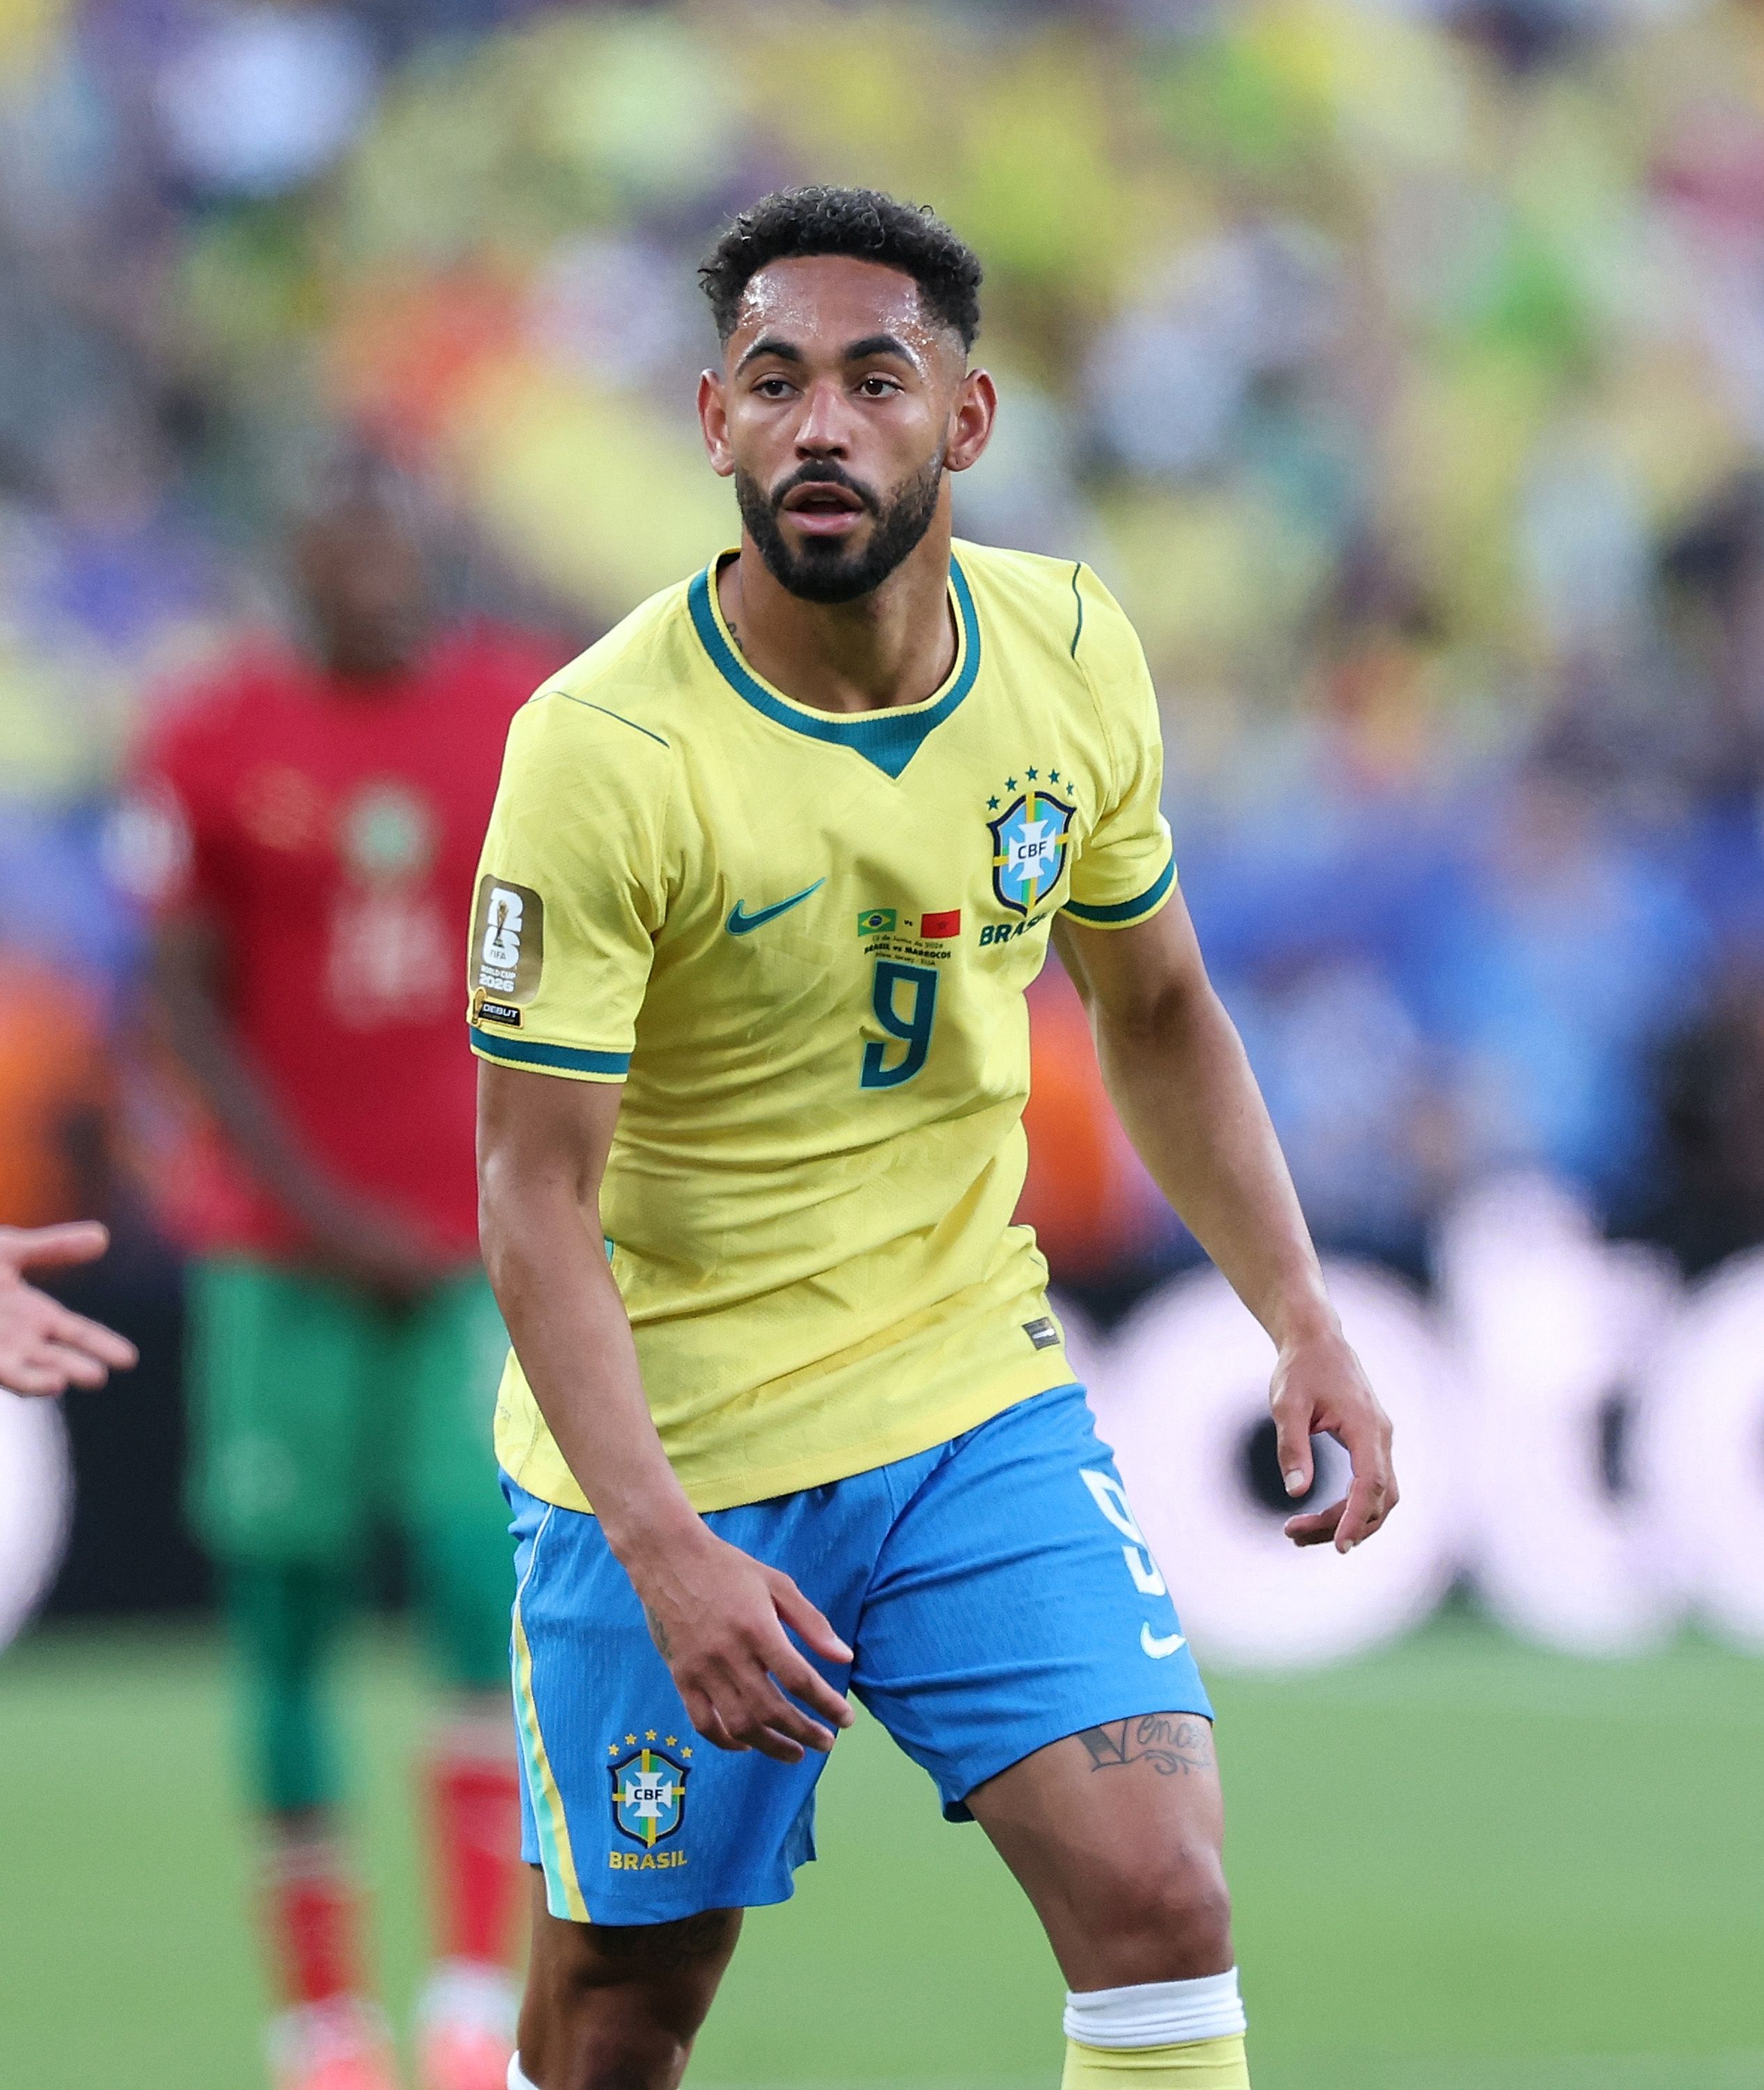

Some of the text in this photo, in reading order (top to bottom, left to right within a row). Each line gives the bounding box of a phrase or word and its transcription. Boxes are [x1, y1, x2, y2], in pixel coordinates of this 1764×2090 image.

[1017, 841, 1047, 859] CBF
[490, 949, 506, 961] FIFA
[479, 973, 514, 993] 2026
[501, 970, 516, 980] CUP
[483, 1004, 518, 1018] DEBUT
[859, 958, 939, 1090] 9
[1078, 1468, 1166, 1596] 9
[633, 1788, 664, 1800] CBF
[608, 1850, 688, 1871] BRASIL
